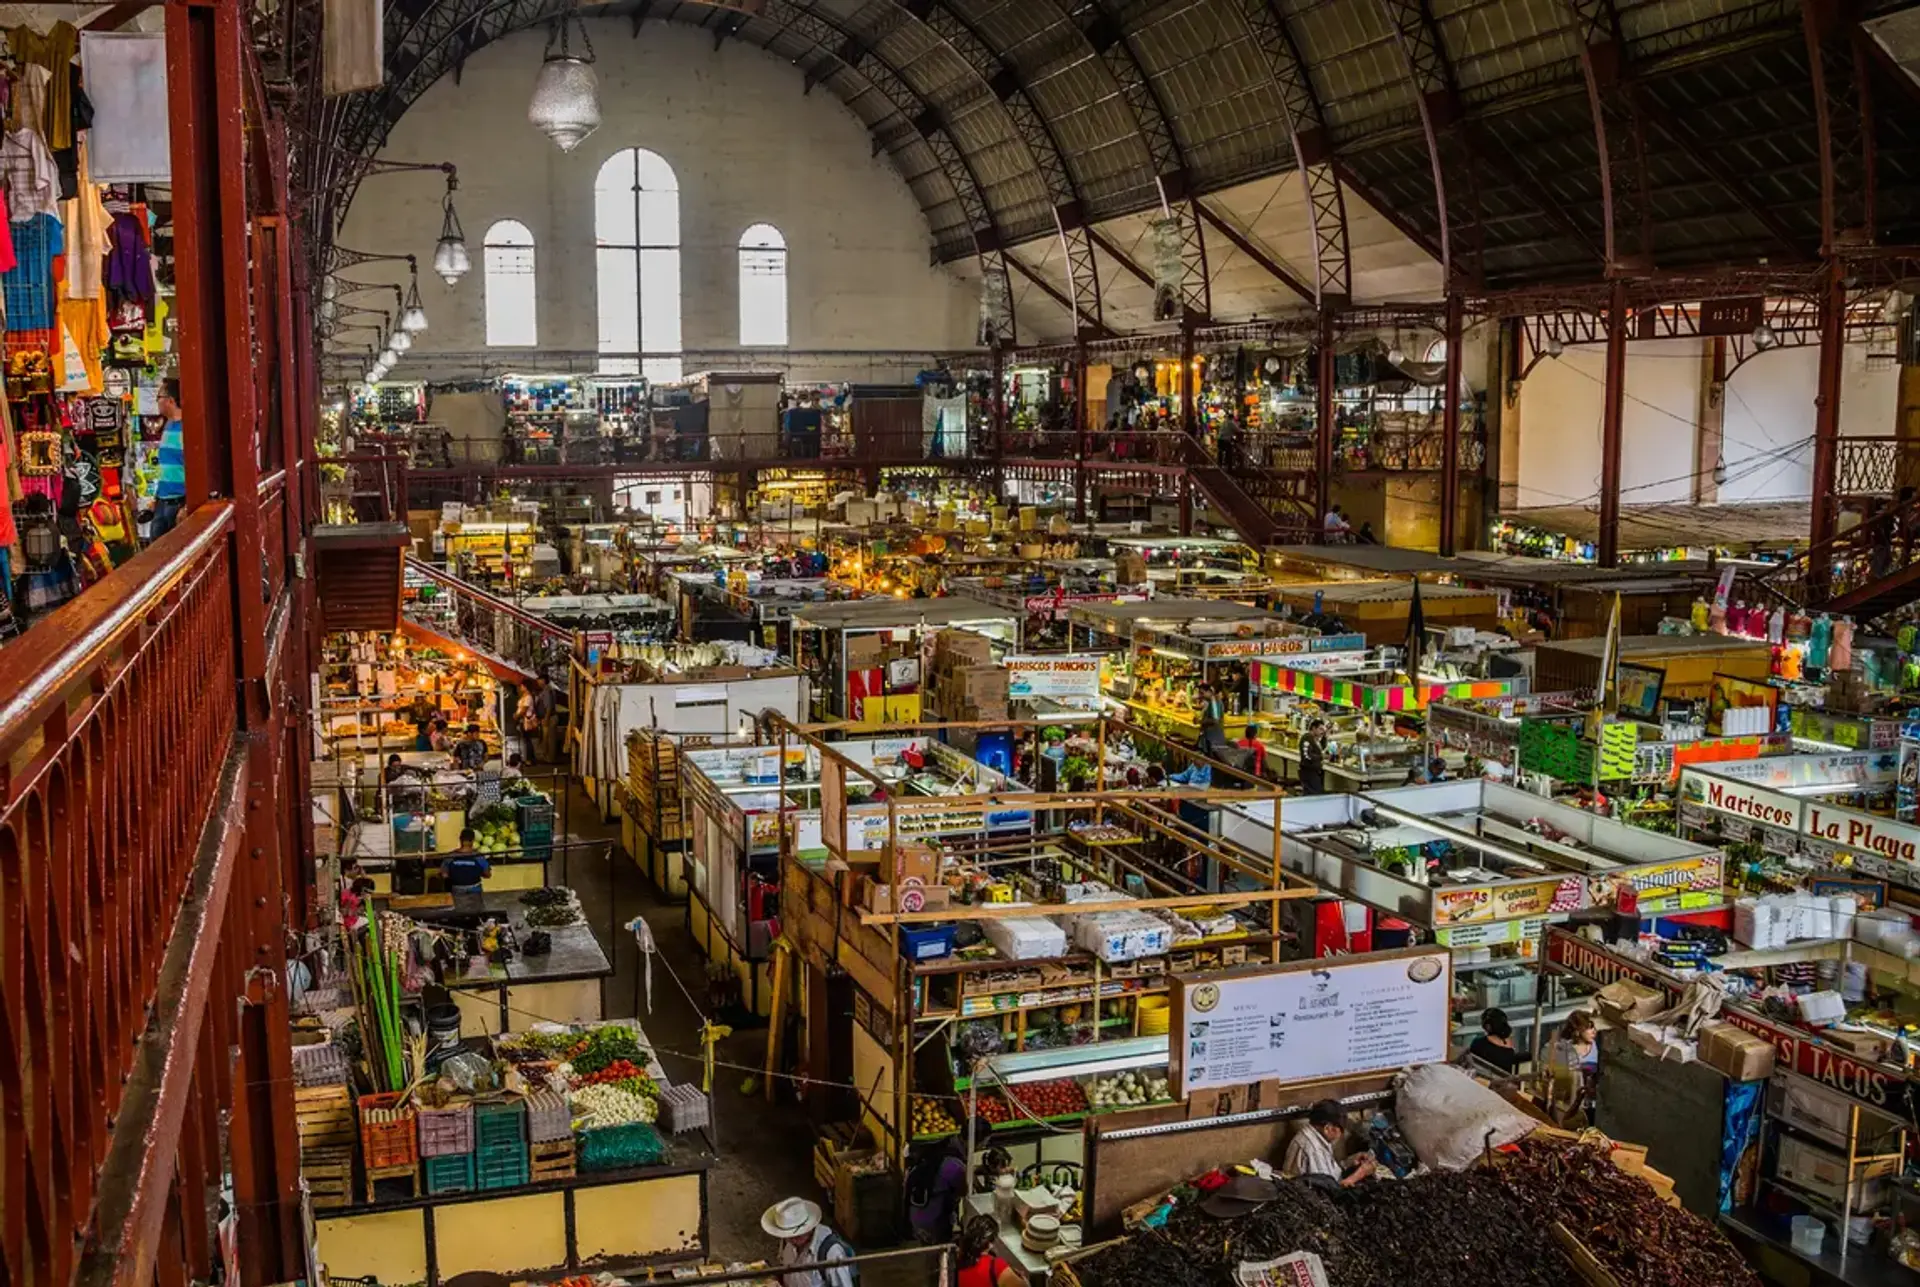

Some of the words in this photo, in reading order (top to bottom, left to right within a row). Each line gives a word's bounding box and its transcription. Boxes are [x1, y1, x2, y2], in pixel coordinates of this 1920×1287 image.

[1264, 640, 1303, 653] JUGOS
[1006, 661, 1051, 671] MARISCOS
[1053, 661, 1096, 671] PANCHO'S
[1708, 781, 1793, 826] Mariscos
[1811, 809, 1840, 839] La
[1848, 819, 1916, 861] Playa
[1441, 891, 1488, 906] TORTAS
[1501, 887, 1538, 902] Cubana
[1293, 1011, 1328, 1021] Restaurant
[1334, 1009, 1345, 1017] Bar
[1810, 1048, 1887, 1105] TACOS
